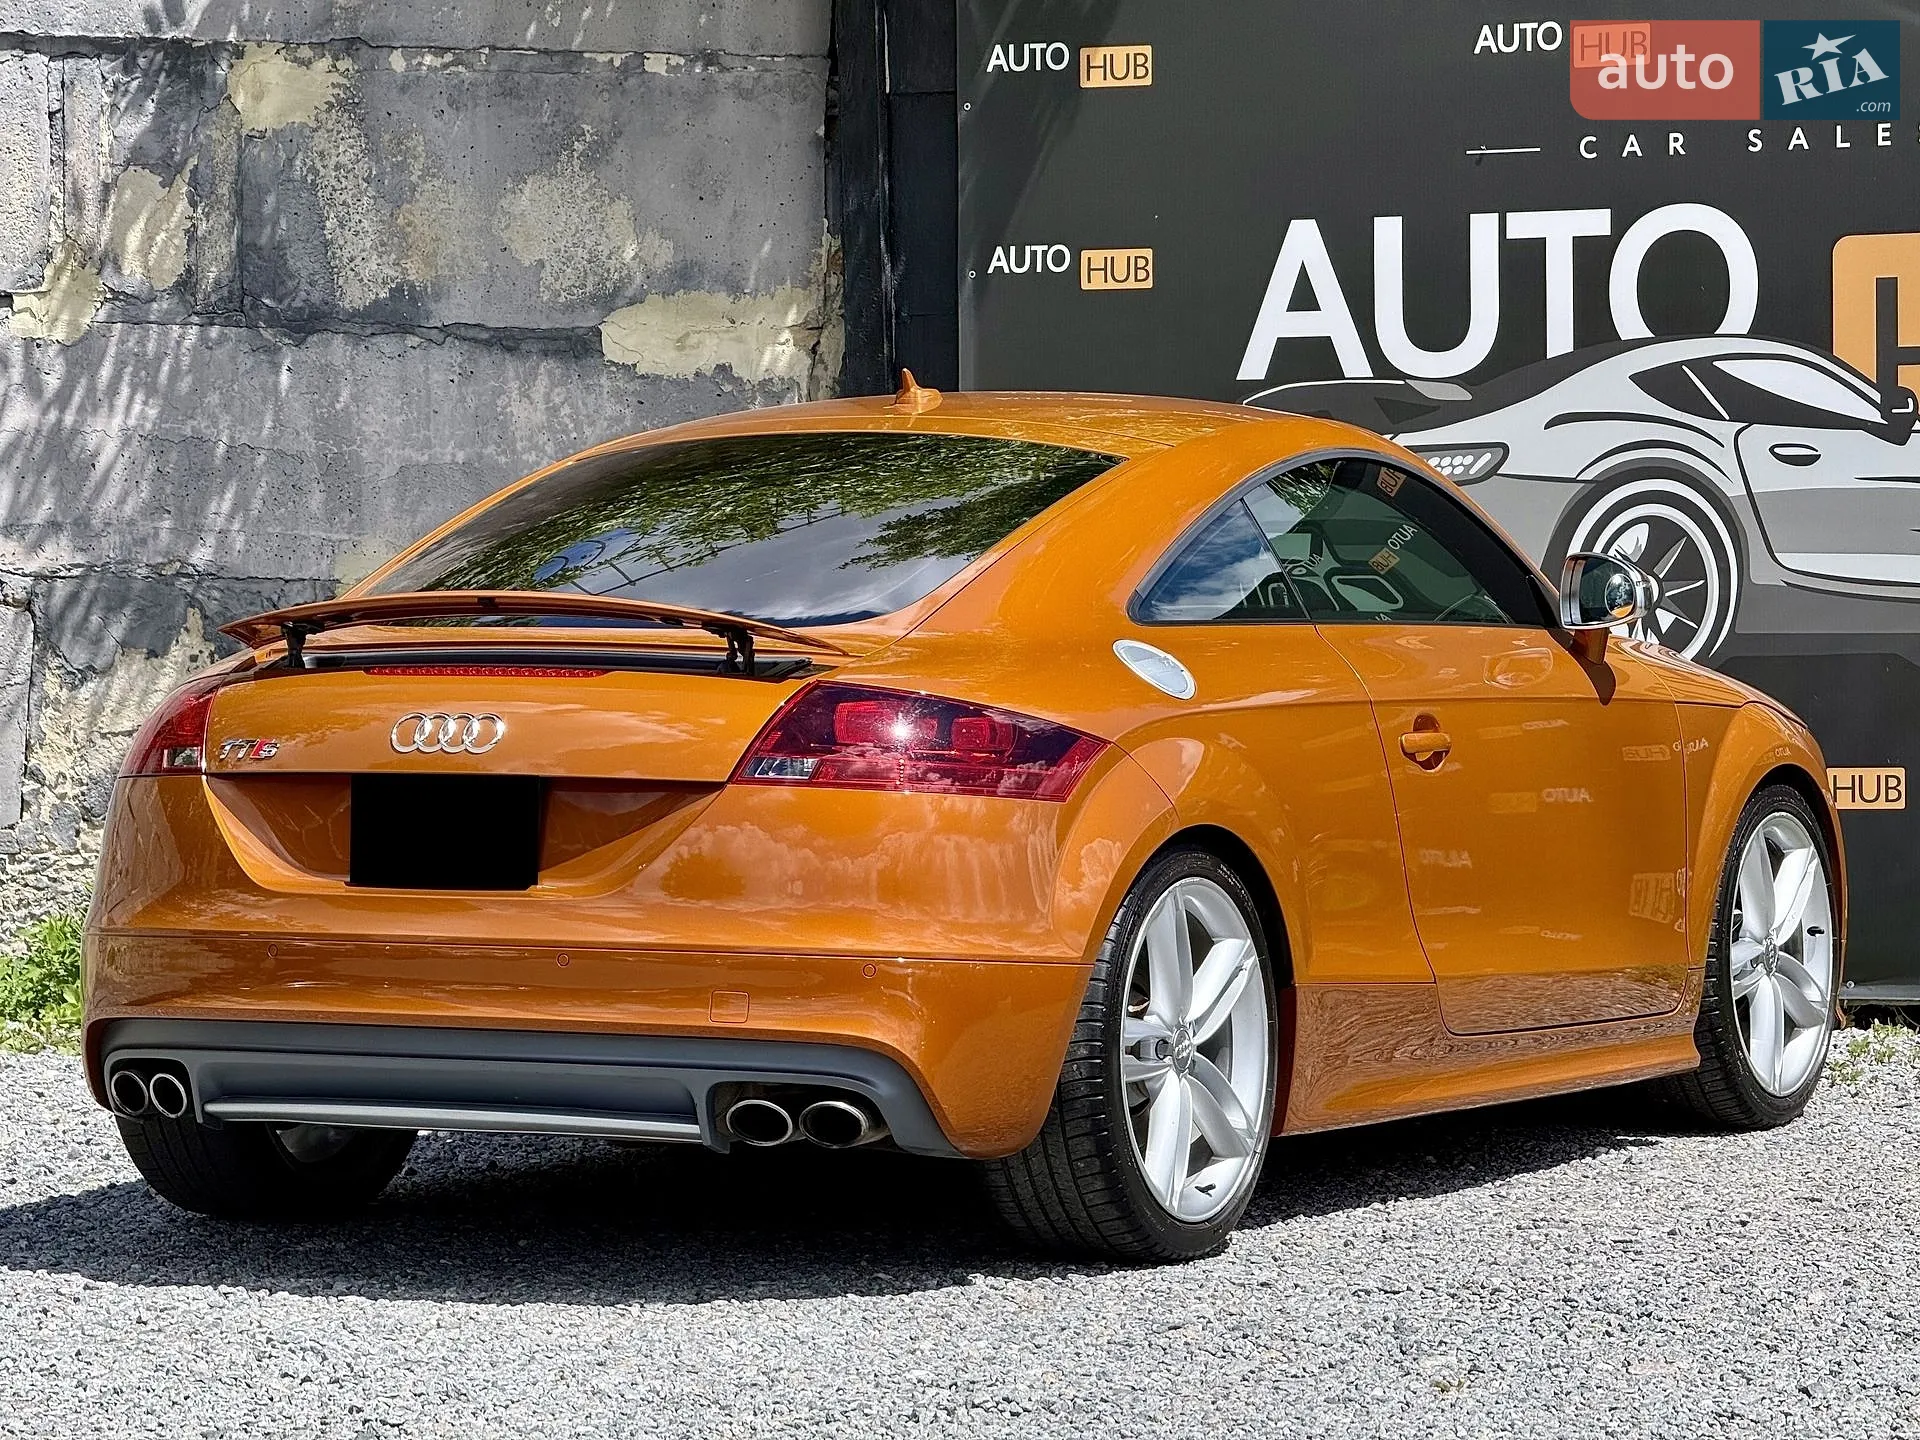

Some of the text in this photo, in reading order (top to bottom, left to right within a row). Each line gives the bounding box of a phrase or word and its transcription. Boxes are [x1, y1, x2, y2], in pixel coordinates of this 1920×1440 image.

[986, 41, 1150, 82] AUTO HUB
[1473, 21, 1649, 63] AUTO HUB
[1579, 122, 1920, 159] CAR SALE
[987, 243, 1150, 284] AUTO HUB
[1236, 203, 1760, 381] AUTO
[220, 739, 280, 759] TTS
[1832, 774, 1903, 804] HUB
